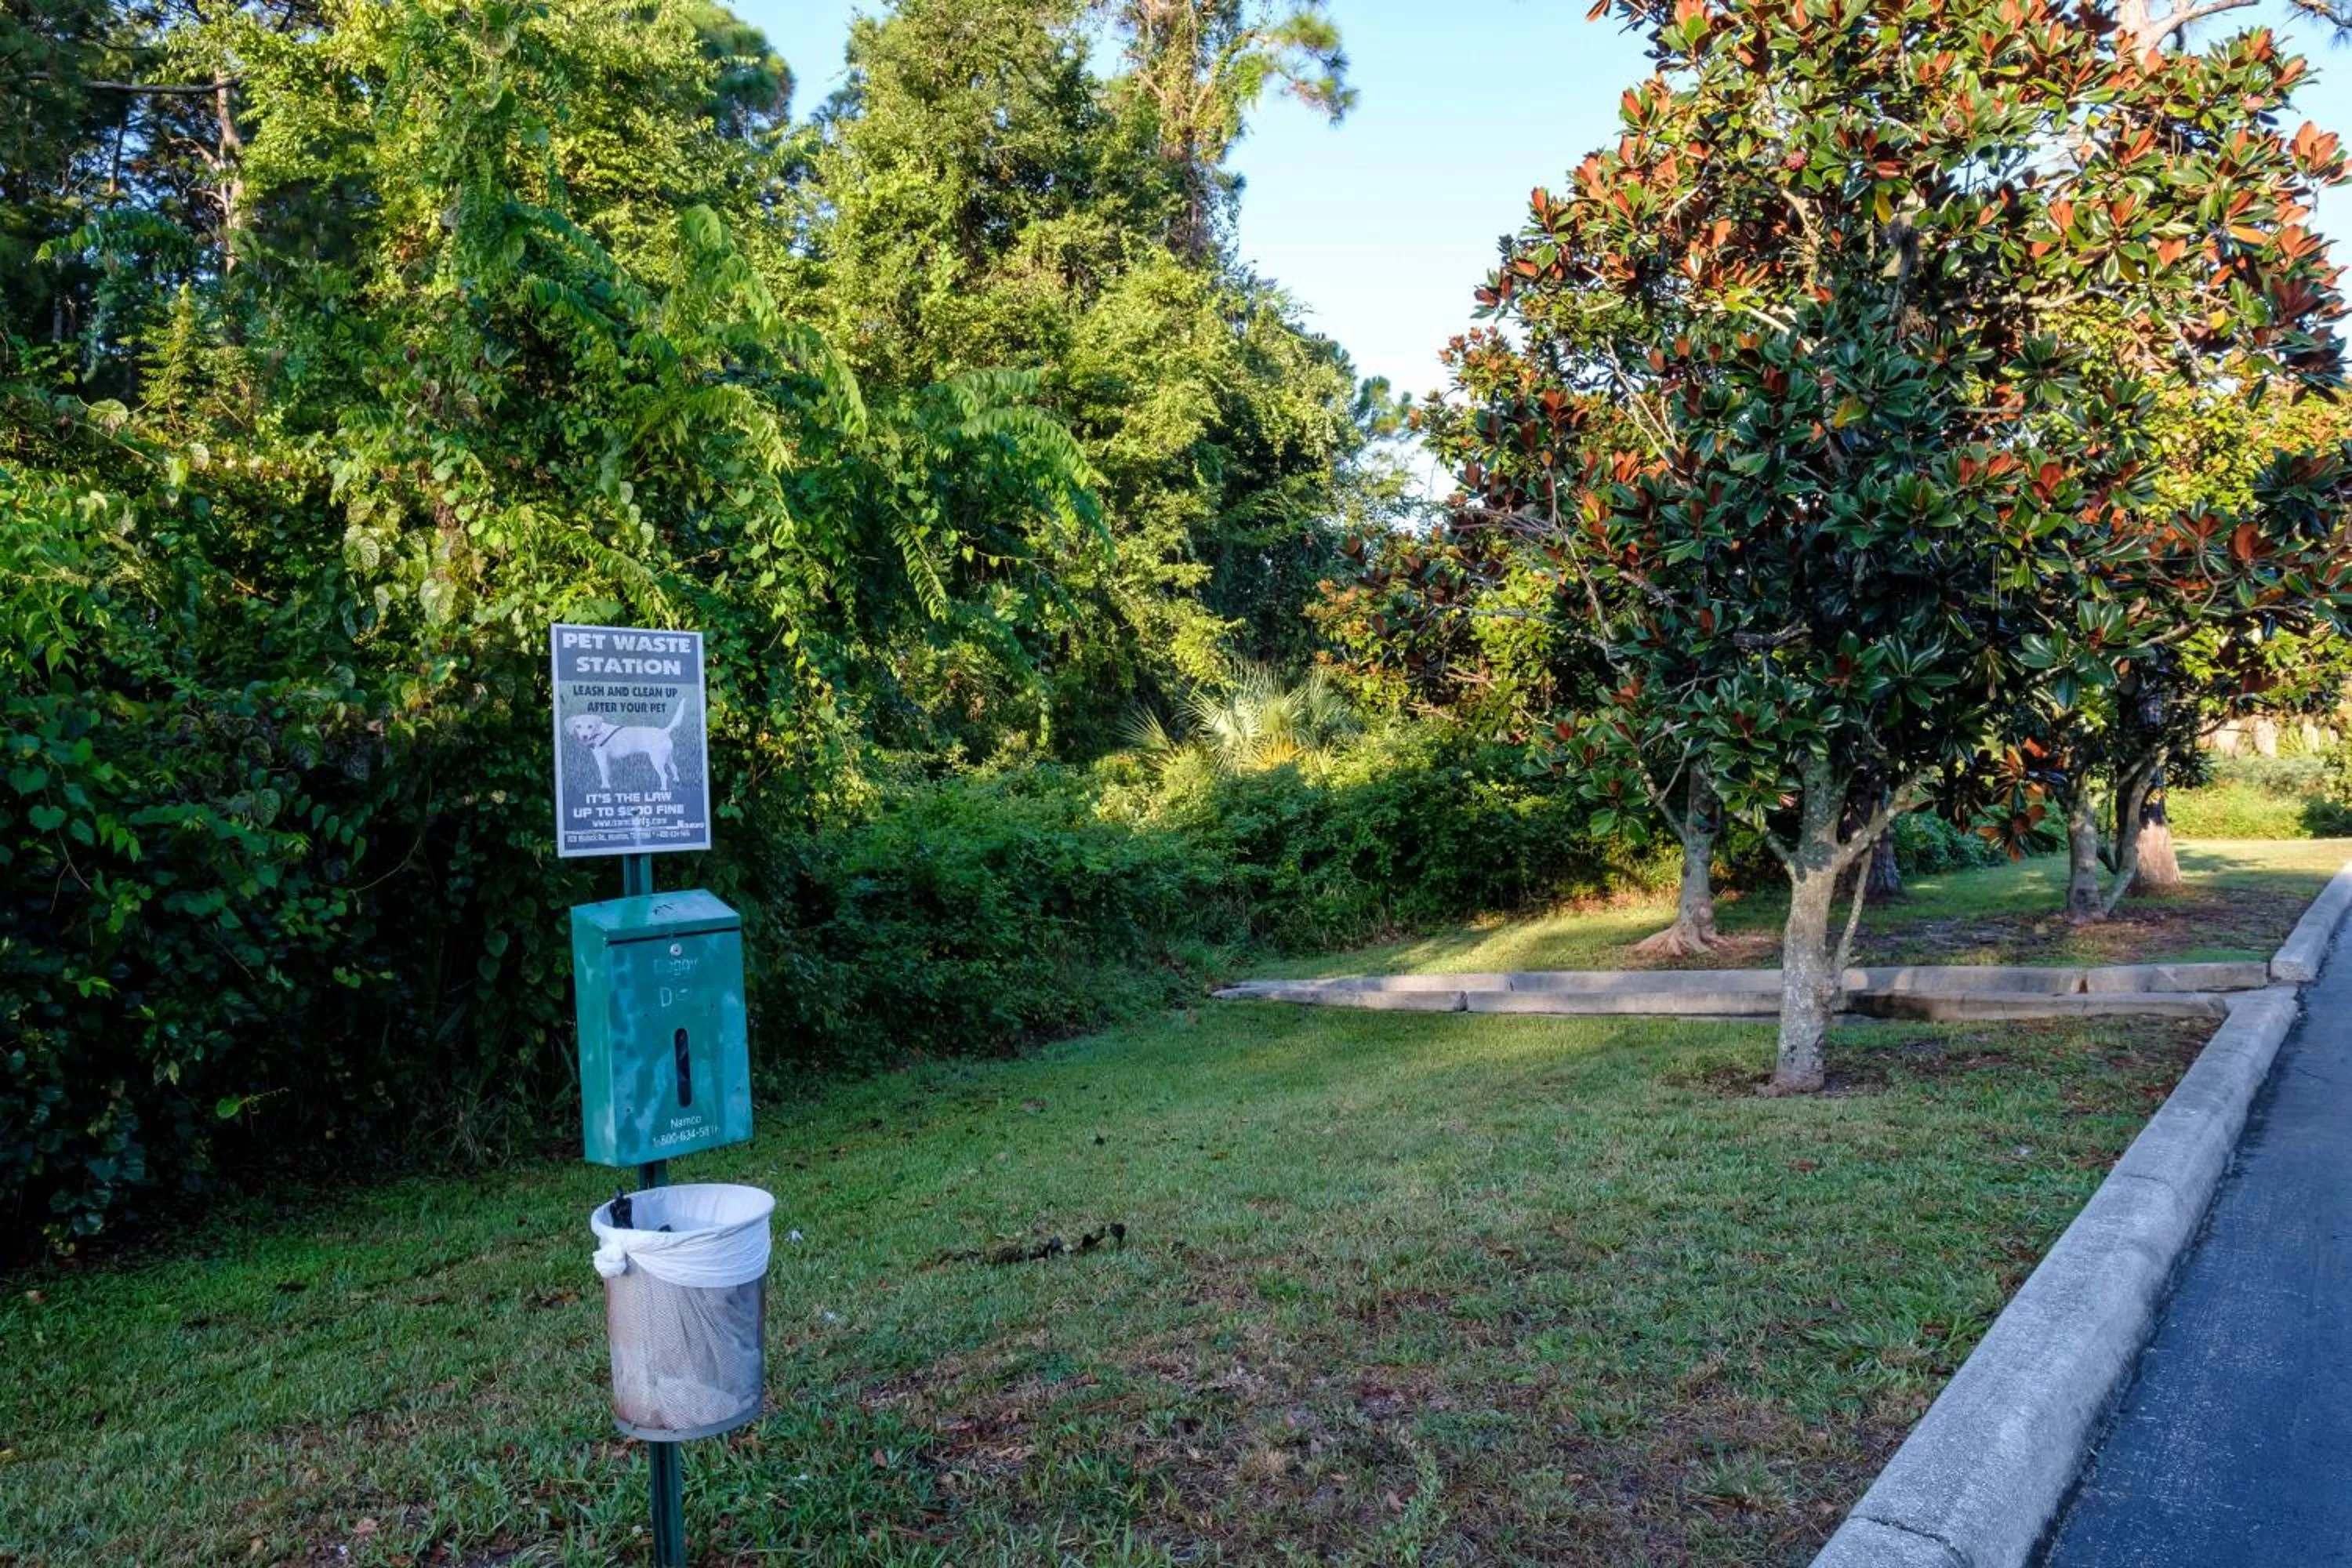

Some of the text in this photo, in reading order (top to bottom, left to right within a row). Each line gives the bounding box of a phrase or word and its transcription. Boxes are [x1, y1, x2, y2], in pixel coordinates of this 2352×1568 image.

[562, 633, 691, 653] PET WASTE
[576, 656, 681, 675] STATION
[573, 684, 678, 698] LEASH AND CLEAN UP
[587, 702, 666, 713] AFTER YOUR PET
[586, 791, 673, 804] IT'S THE LAW
[573, 807, 592, 818] UP
[596, 806, 614, 817] TO
[656, 804, 684, 815] FINE
